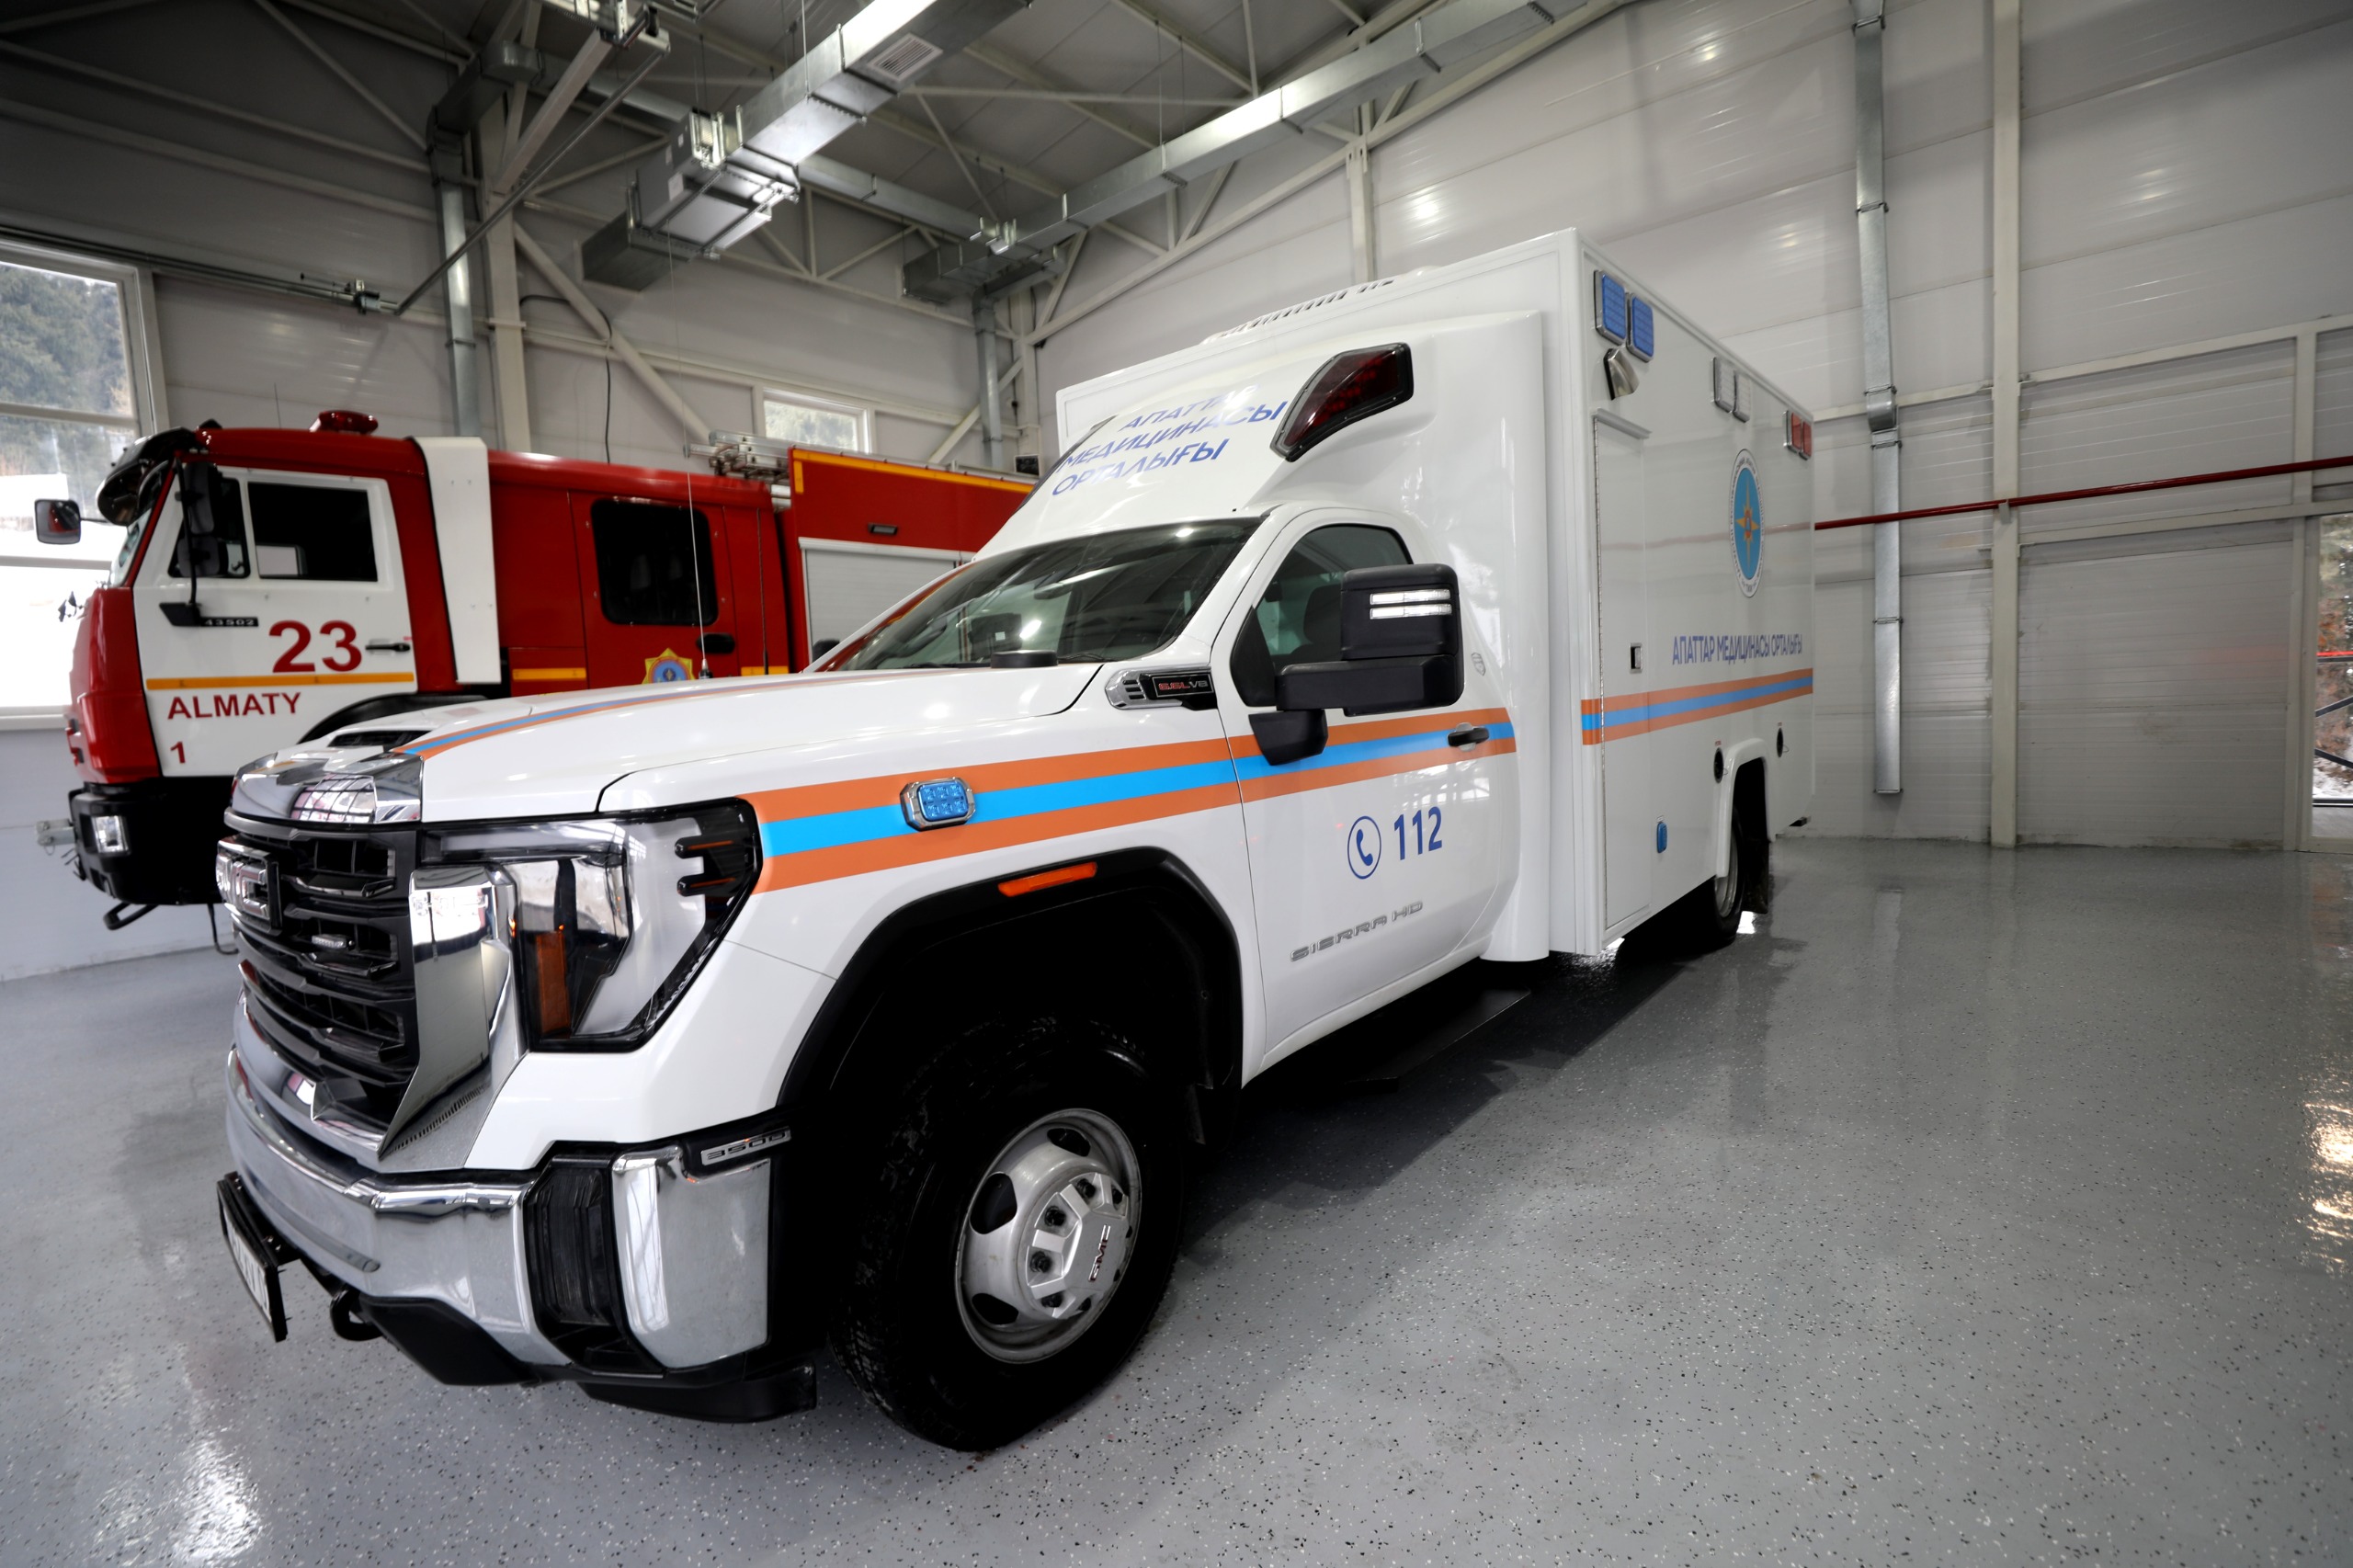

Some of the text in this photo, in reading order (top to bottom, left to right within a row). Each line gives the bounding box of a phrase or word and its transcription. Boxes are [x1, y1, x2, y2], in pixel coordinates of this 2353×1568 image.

[1119, 384, 1259, 432] АПАТТАР
[1056, 401, 1289, 472] МЕДИЦИНАСЫ
[1052, 438, 1230, 496] ОРТАЛЫҒЫ
[269, 619, 362, 673] 23
[1672, 635, 1715, 665] АПАТТАР
[1717, 634, 1770, 665] МЕДИЦИНАСЫ
[167, 692, 301, 720] ALMATY
[170, 742, 187, 764] 1
[1393, 806, 1443, 861] 112
[1290, 900, 1424, 962] SIERRA HD
[707, 1131, 787, 1160] 3500
[1088, 1224, 1111, 1282] GMC
